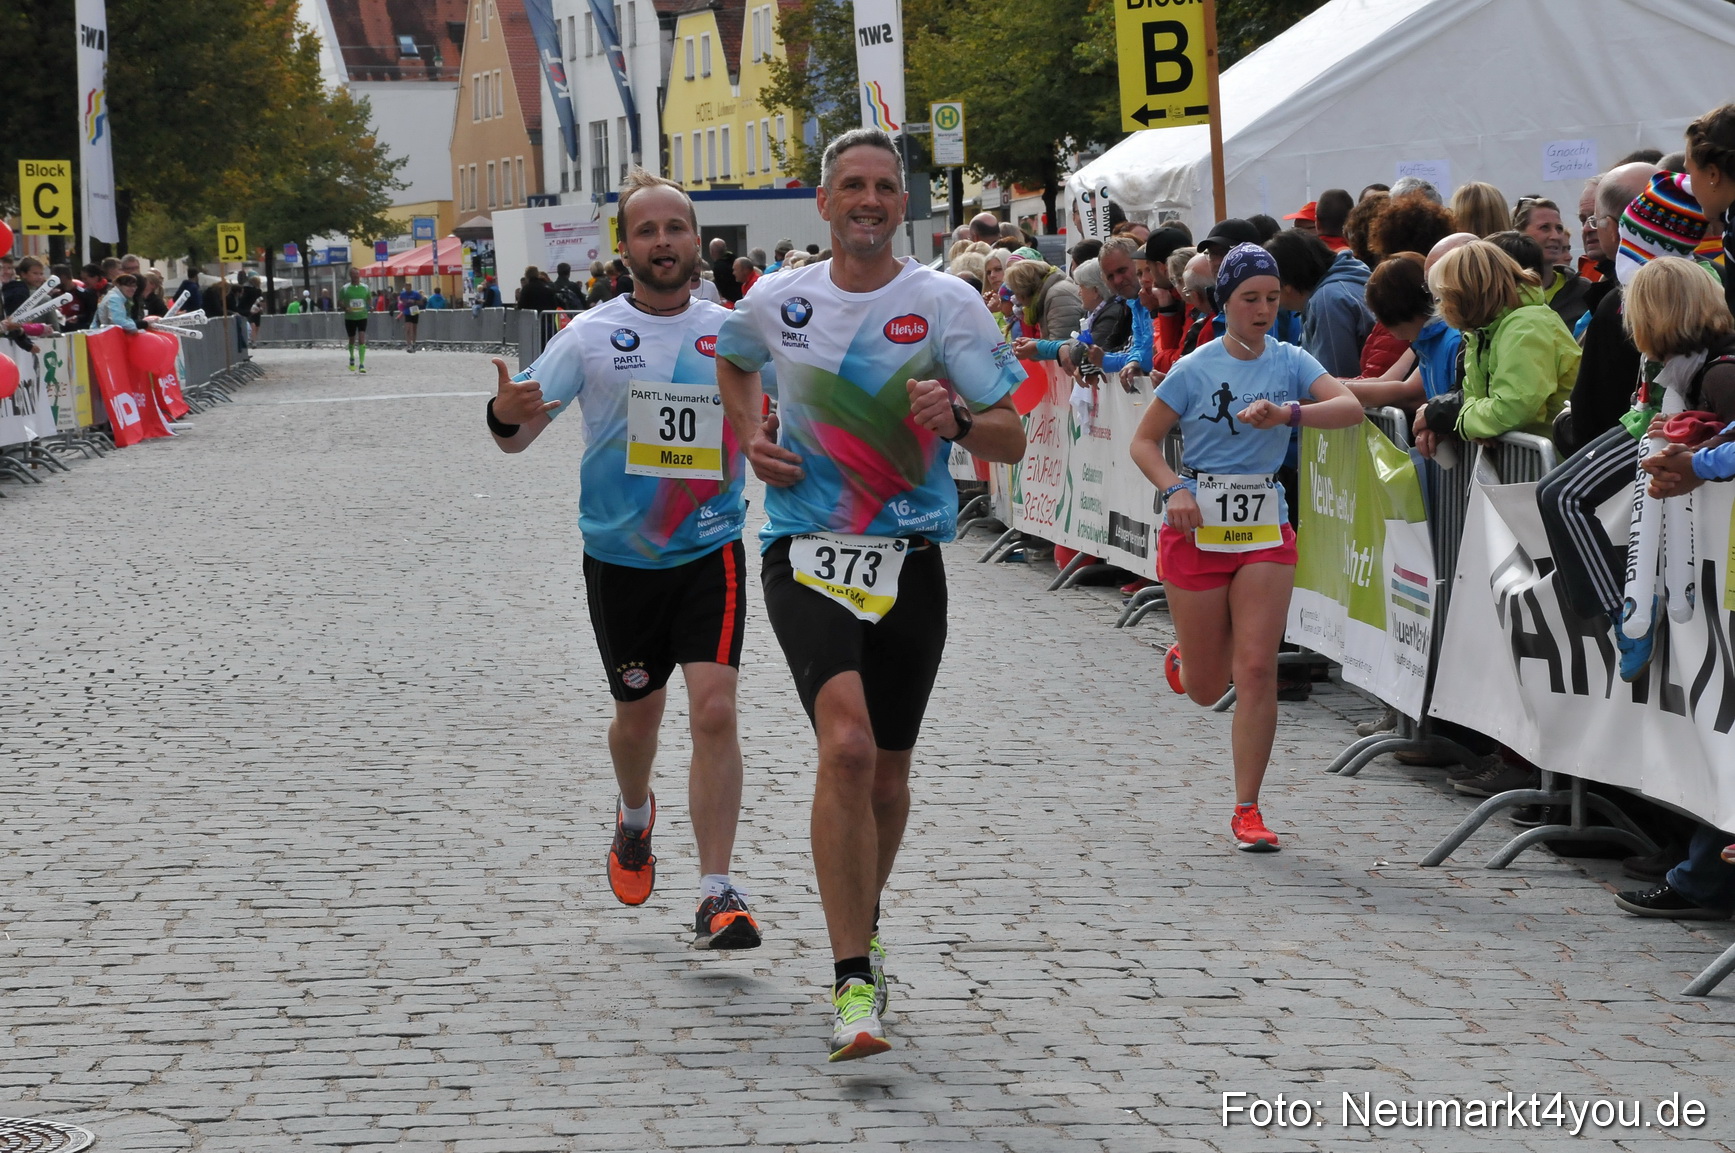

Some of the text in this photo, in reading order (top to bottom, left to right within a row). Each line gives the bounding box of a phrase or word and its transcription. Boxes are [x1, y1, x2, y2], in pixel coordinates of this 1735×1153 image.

[1142, 20, 1194, 96] B
[696, 102, 714, 122] HOTEL
[1546, 144, 1590, 157] Gnocchi
[25, 164, 65, 176] Block
[33, 182, 60, 219] C
[225, 235, 239, 253] D
[781, 331, 810, 342] PARTL
[890, 323, 924, 336] Hervis
[781, 340, 809, 349] Neumarkt
[613, 355, 645, 364] PARTL
[615, 362, 646, 371] Neumarkt
[631, 390, 709, 403] PARTL Neumarkt
[659, 406, 696, 442] 30
[1317, 433, 1328, 464] Der
[661, 450, 693, 465] Maze
[1199, 481, 1228, 490] PARTL
[1310, 461, 1334, 517] Neue
[888, 499, 916, 516] 16.
[1216, 494, 1266, 522] 137
[898, 509, 942, 526] Neumarkter
[1224, 530, 1253, 541] Alena
[814, 546, 882, 588] 373
